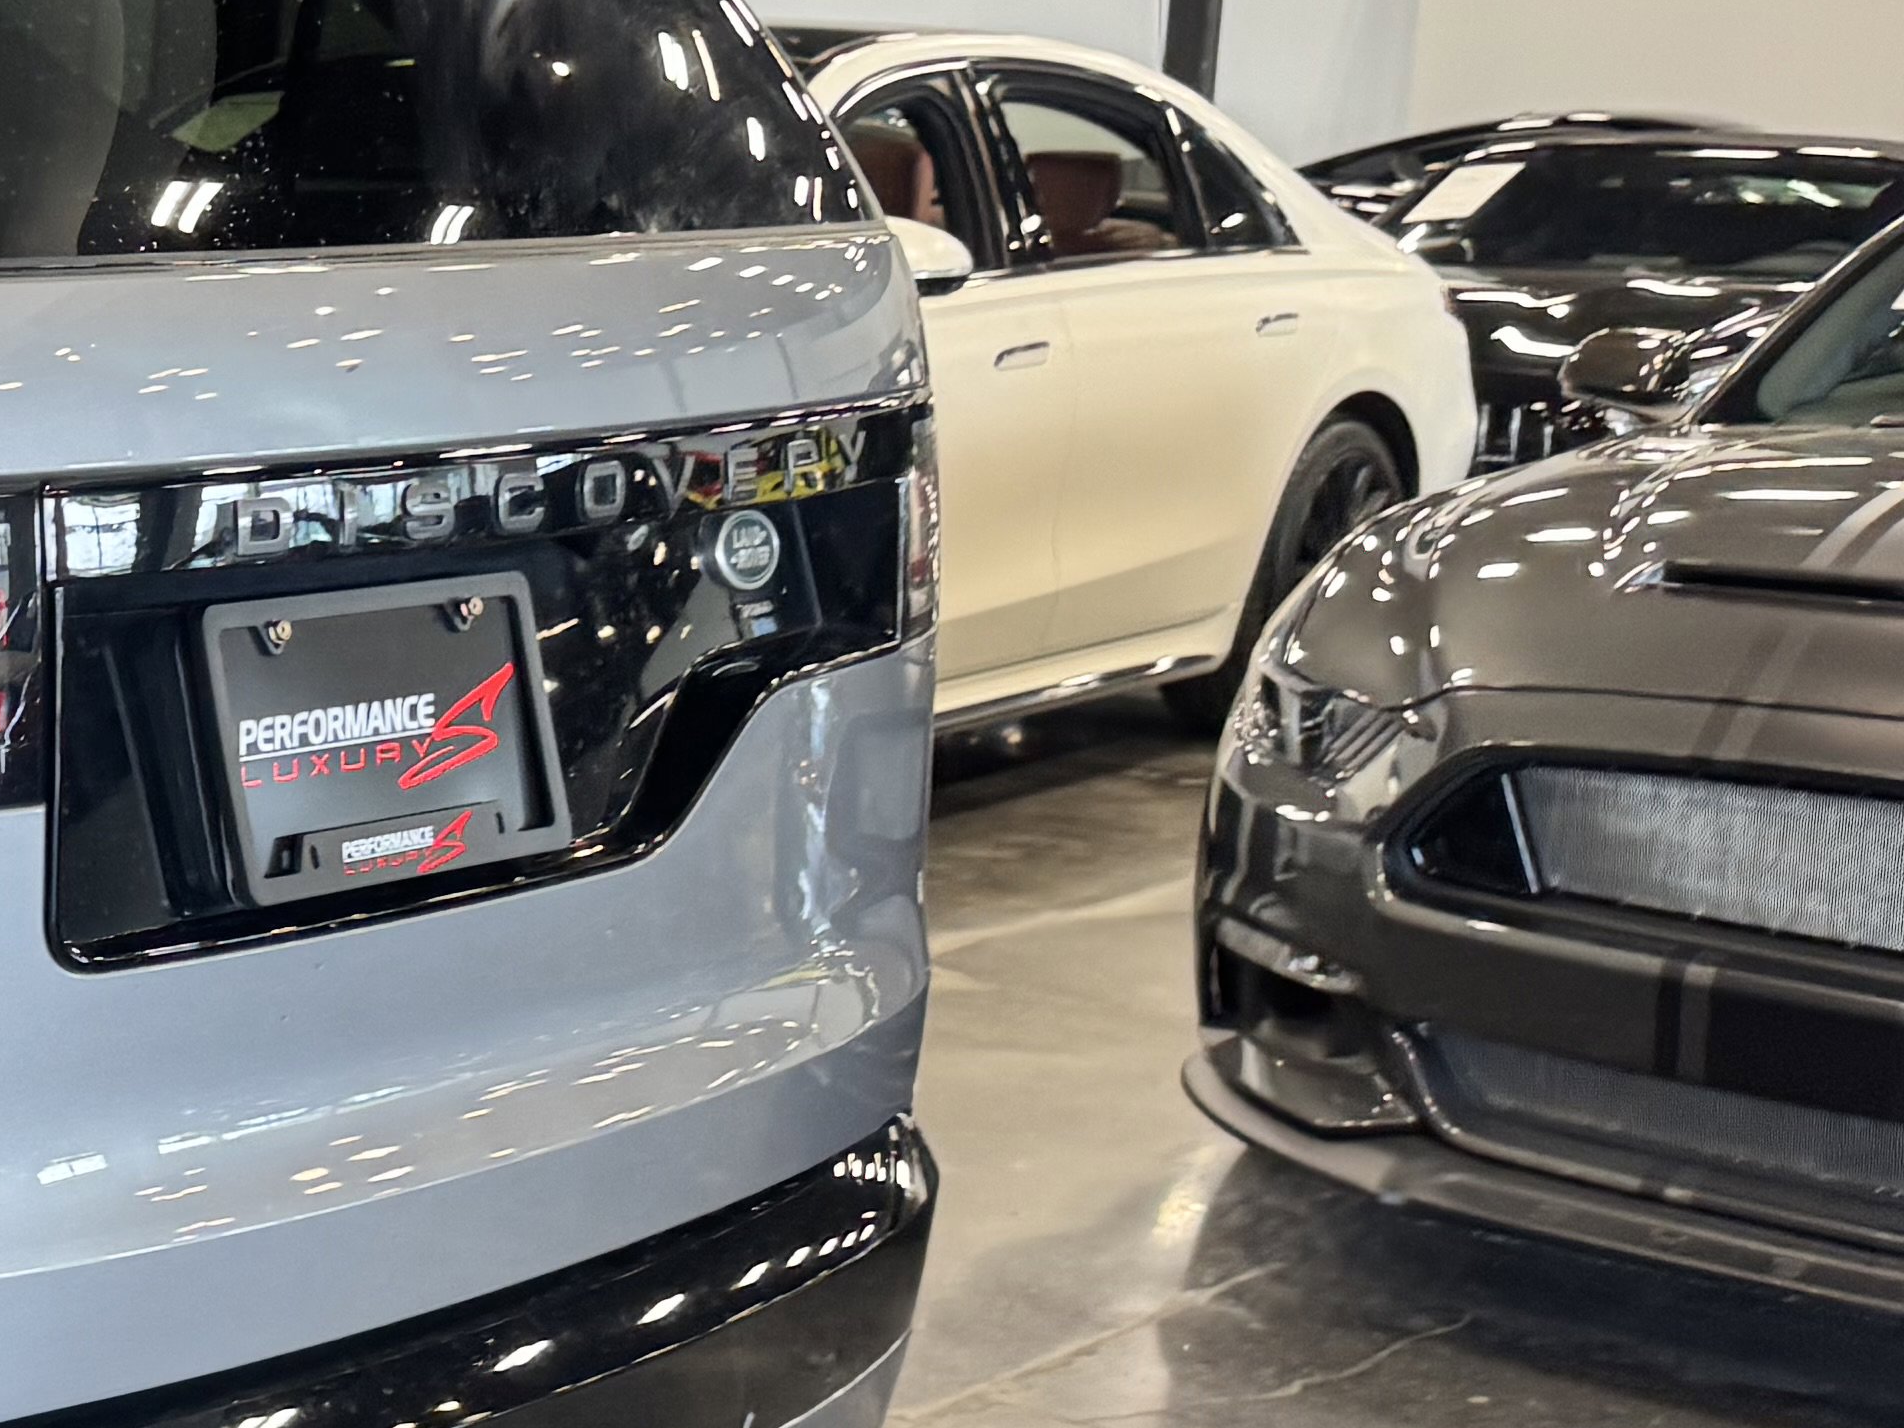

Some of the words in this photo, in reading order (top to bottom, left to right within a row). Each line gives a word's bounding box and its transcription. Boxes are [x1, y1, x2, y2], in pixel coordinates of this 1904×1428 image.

[237, 429, 866, 558] DISCOVERY
[239, 693, 435, 756] PERFORMANCE
[241, 736, 434, 788] LUXURY
[342, 825, 433, 860] PERFORMANCE
